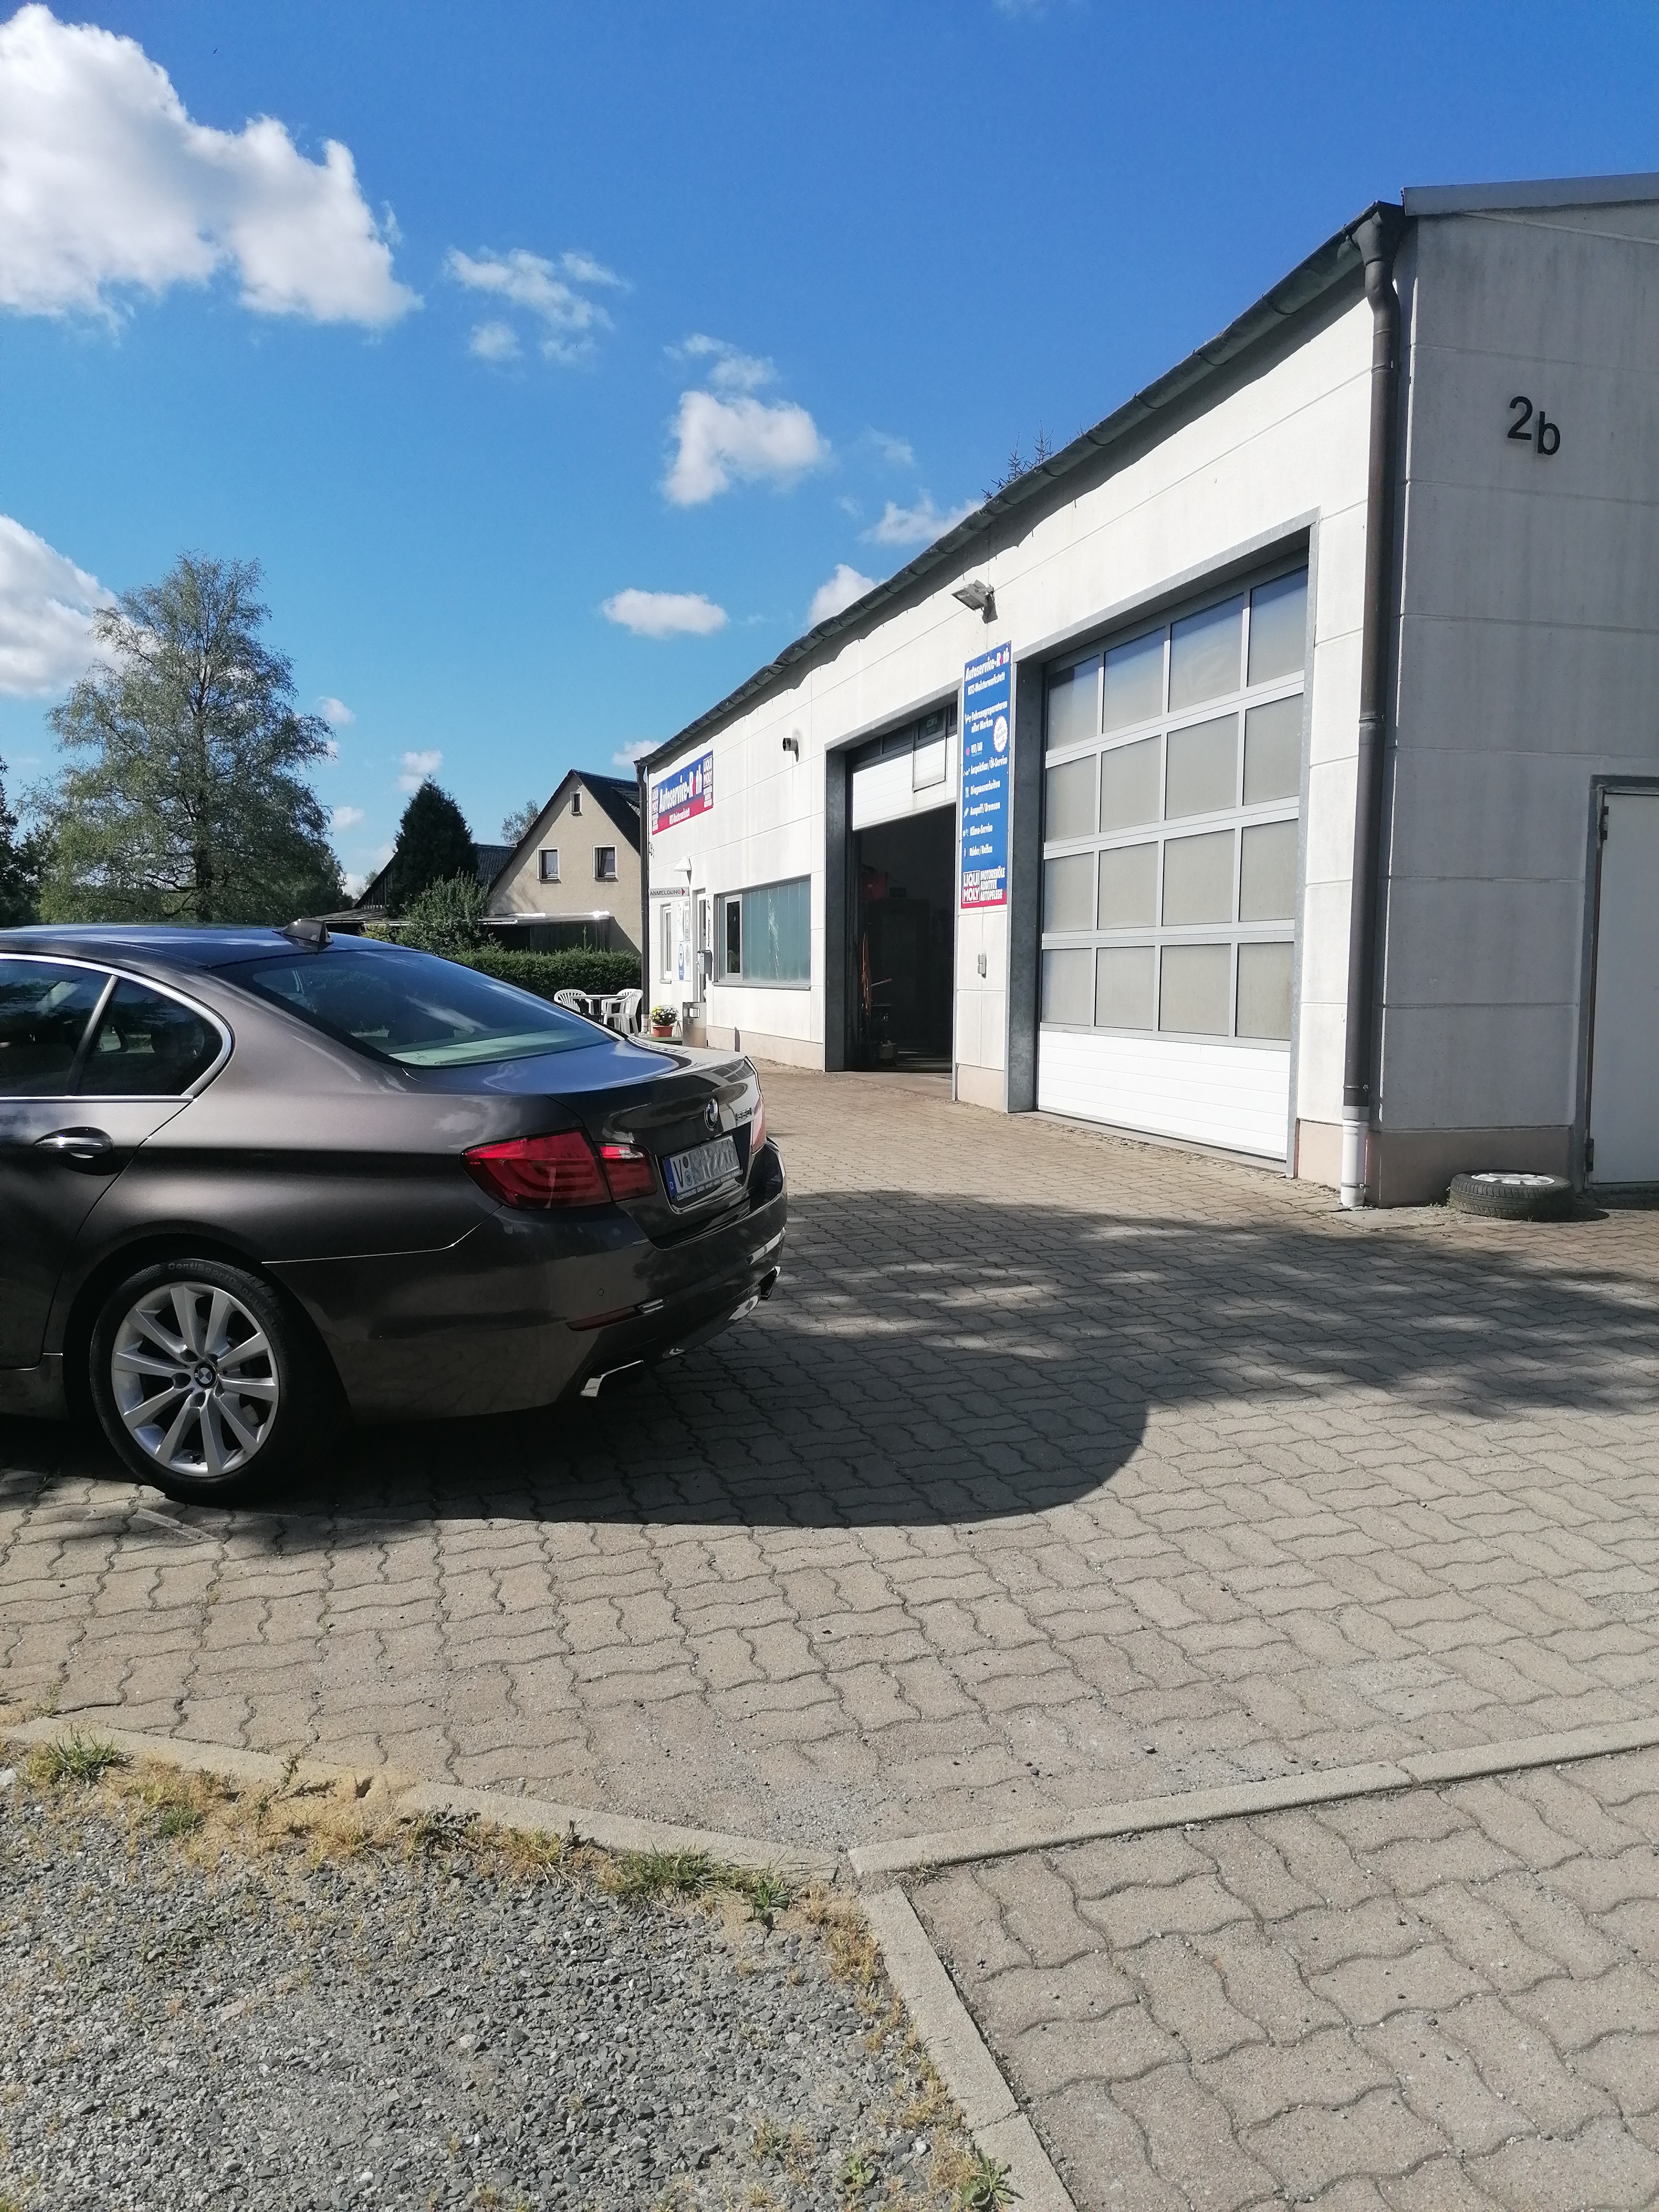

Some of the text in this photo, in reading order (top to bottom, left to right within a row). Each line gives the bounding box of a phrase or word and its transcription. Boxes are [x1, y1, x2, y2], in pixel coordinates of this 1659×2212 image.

[1507, 396, 1561, 456] 2b
[963, 872, 979, 902] LIQUI MOLY
